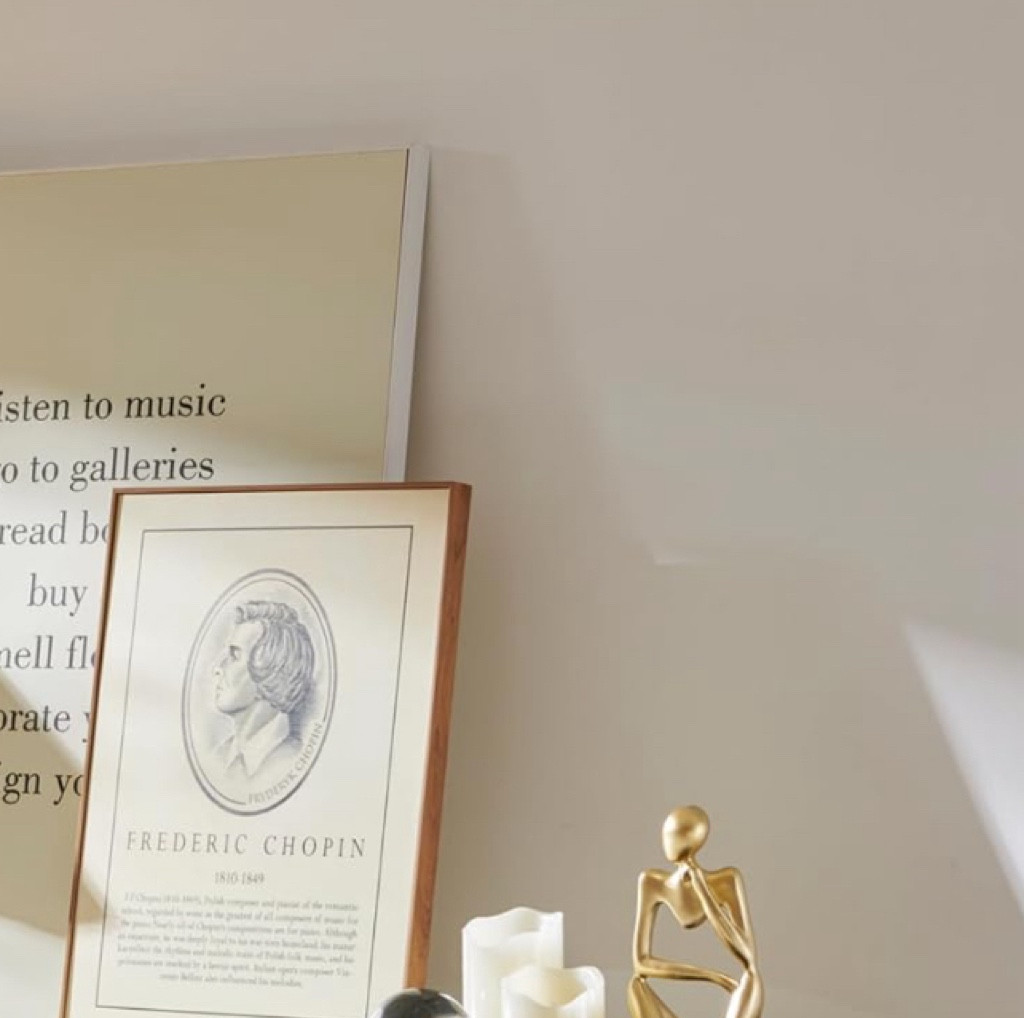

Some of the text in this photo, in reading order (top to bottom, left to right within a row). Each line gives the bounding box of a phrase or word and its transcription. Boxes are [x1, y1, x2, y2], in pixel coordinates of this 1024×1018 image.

[84, 393, 112, 420] to
[125, 384, 226, 419] music
[31, 456, 59, 483] to
[70, 447, 215, 491] galleries
[27, 573, 88, 617] buy
[65, 635, 96, 669] fl
[126, 830, 366, 859] FREDERIC CHOPIN
